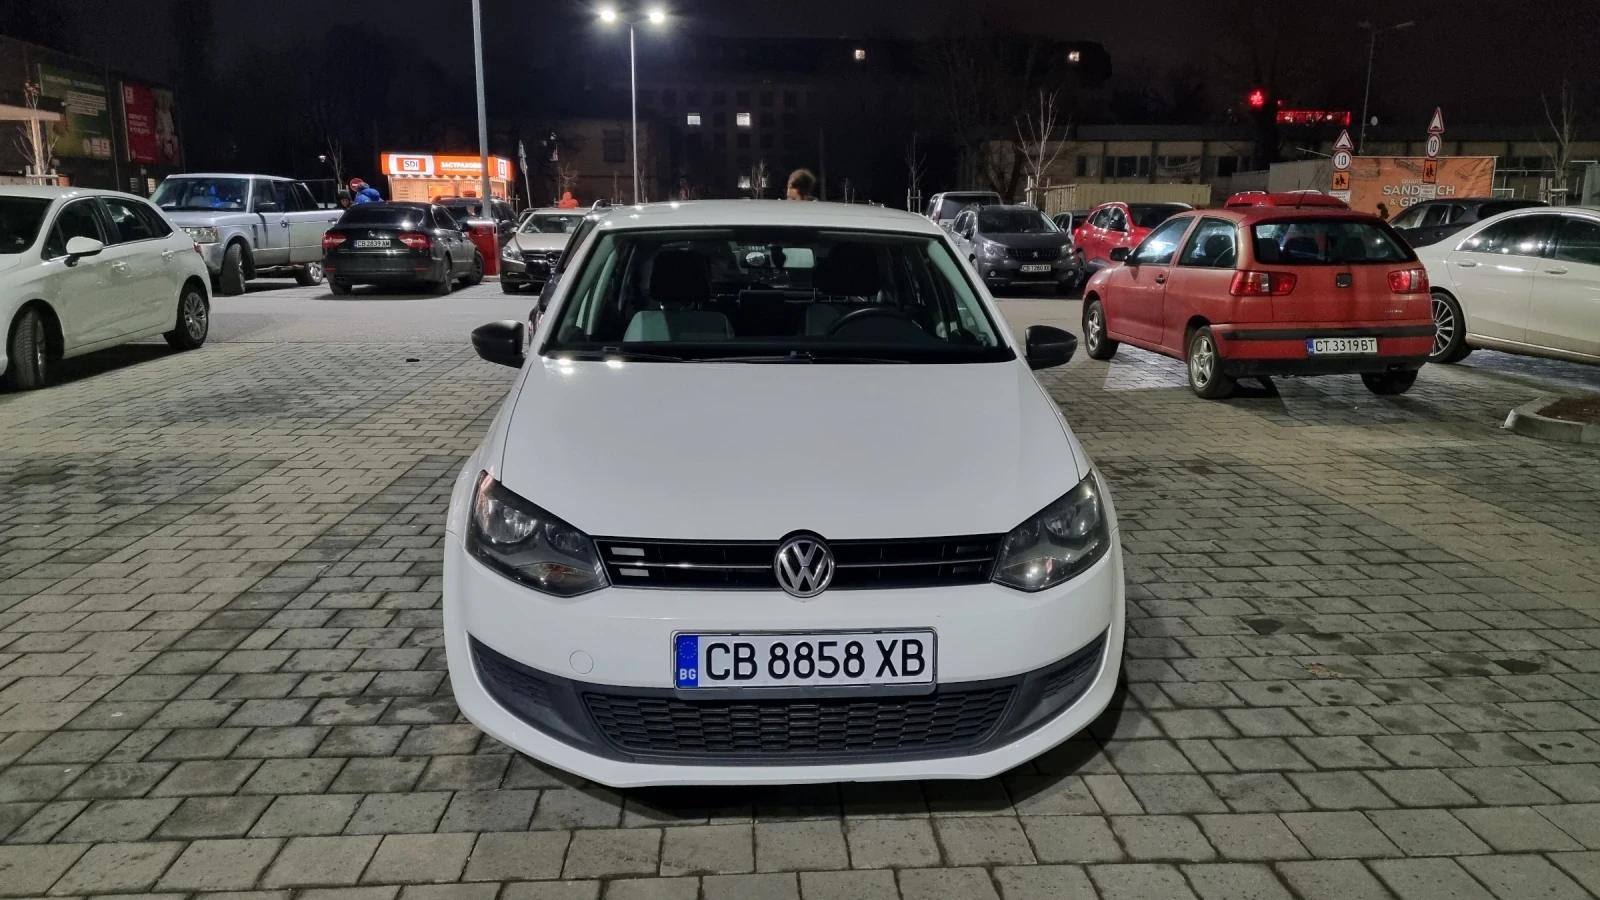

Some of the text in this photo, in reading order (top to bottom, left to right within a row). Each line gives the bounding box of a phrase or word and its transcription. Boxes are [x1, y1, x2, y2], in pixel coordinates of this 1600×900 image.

[1430, 140, 1437, 153] 10
[404, 160, 418, 168] SDI
[1338, 155, 1347, 166] 10
[1383, 184, 1456, 196] SANDCH
[1389, 198, 1396, 206] &
[705, 638, 926, 681] CB 8858 XB
[679, 668, 697, 680] BG
